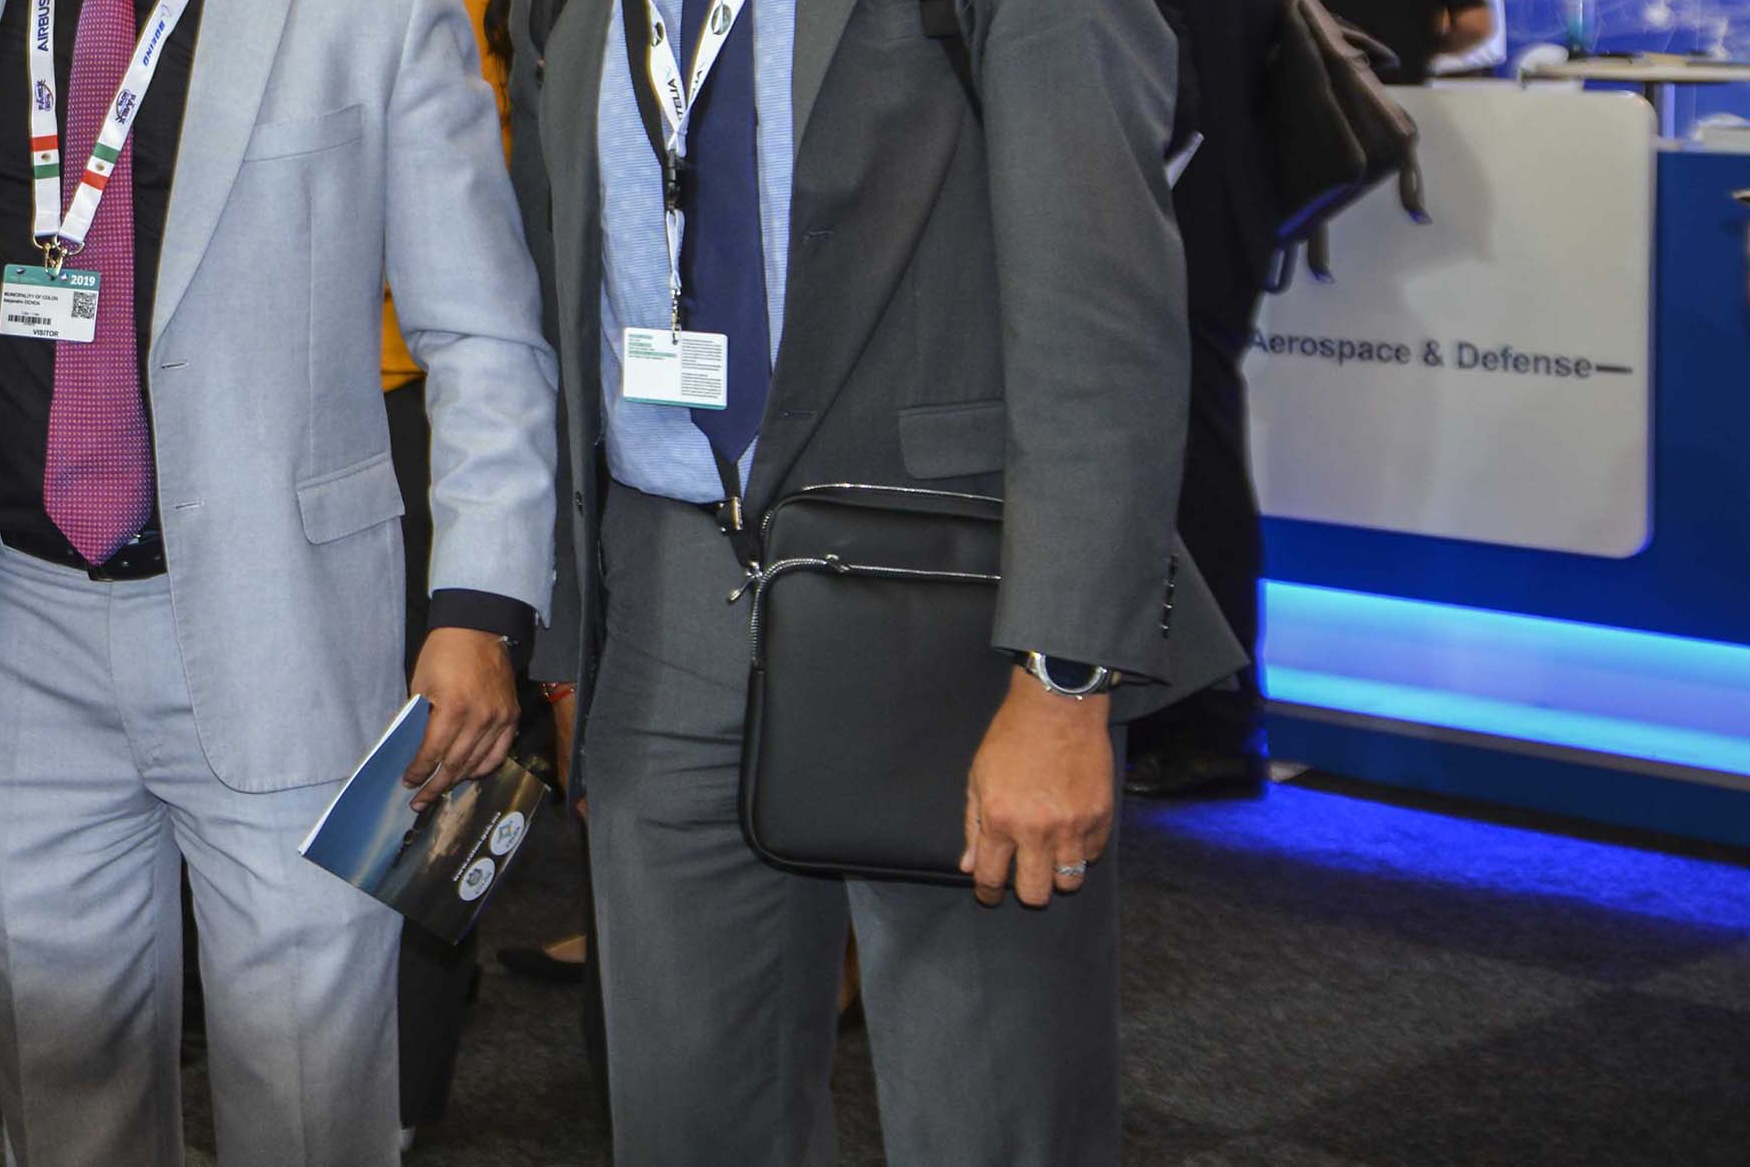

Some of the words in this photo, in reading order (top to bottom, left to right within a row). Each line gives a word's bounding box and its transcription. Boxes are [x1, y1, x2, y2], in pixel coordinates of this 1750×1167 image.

[142, 19, 166, 67] BOEING
[667, 78, 684, 121] TELIA
[70, 274, 96, 286] 2019
[33, 329, 59, 337] VISITOR
[1251, 328, 1411, 365] Aerospace
[1423, 340, 1444, 366] &
[1456, 342, 1592, 379] Defense
